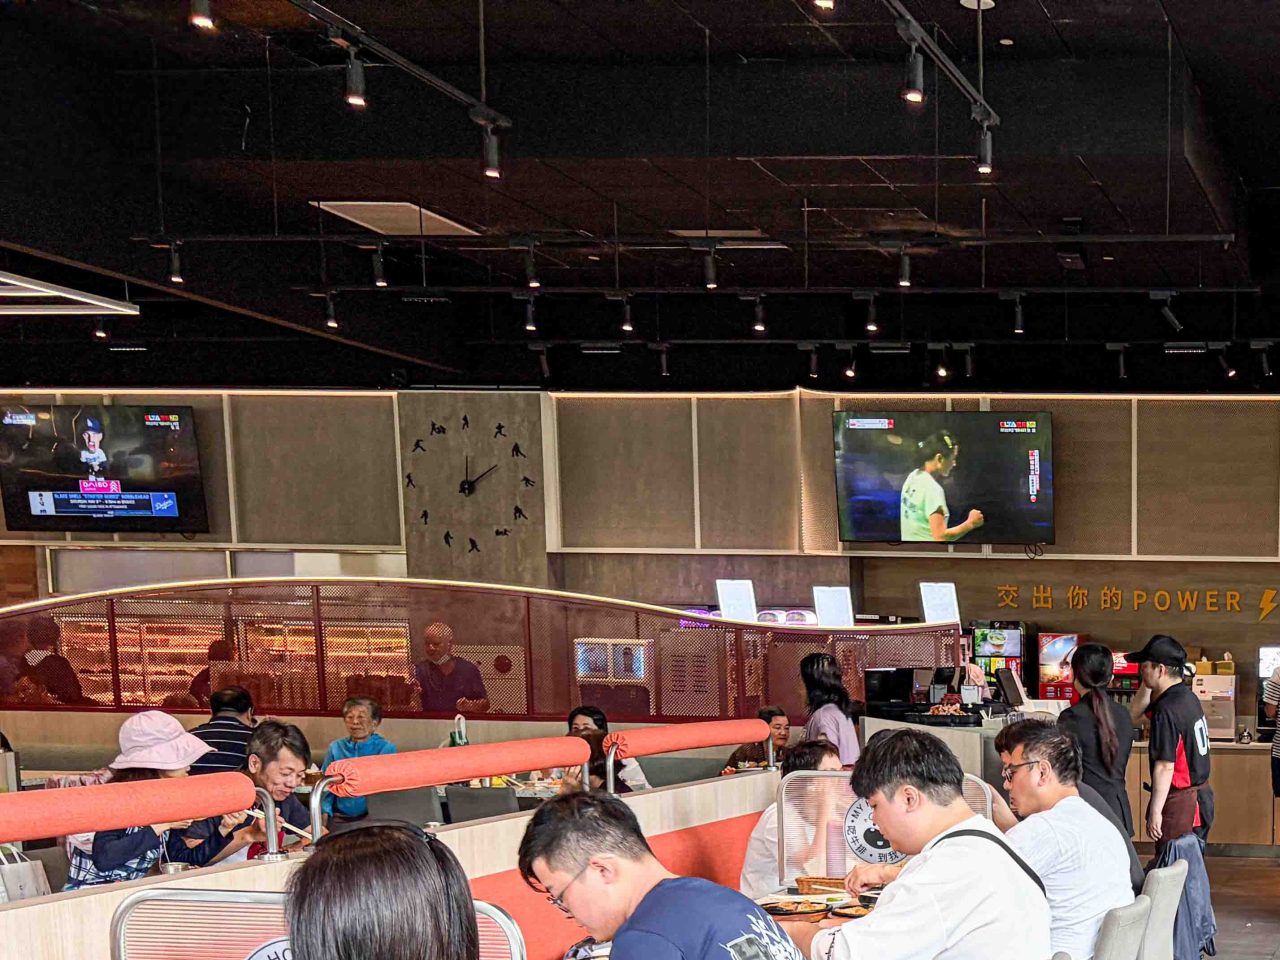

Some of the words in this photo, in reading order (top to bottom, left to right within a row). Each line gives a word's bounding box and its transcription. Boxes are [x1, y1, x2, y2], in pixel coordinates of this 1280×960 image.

[997, 585, 1122, 610] 交出你的
[1133, 591, 1241, 611] POWER
[851, 804, 864, 819] MY
[878, 850, 903, 863] 到我
